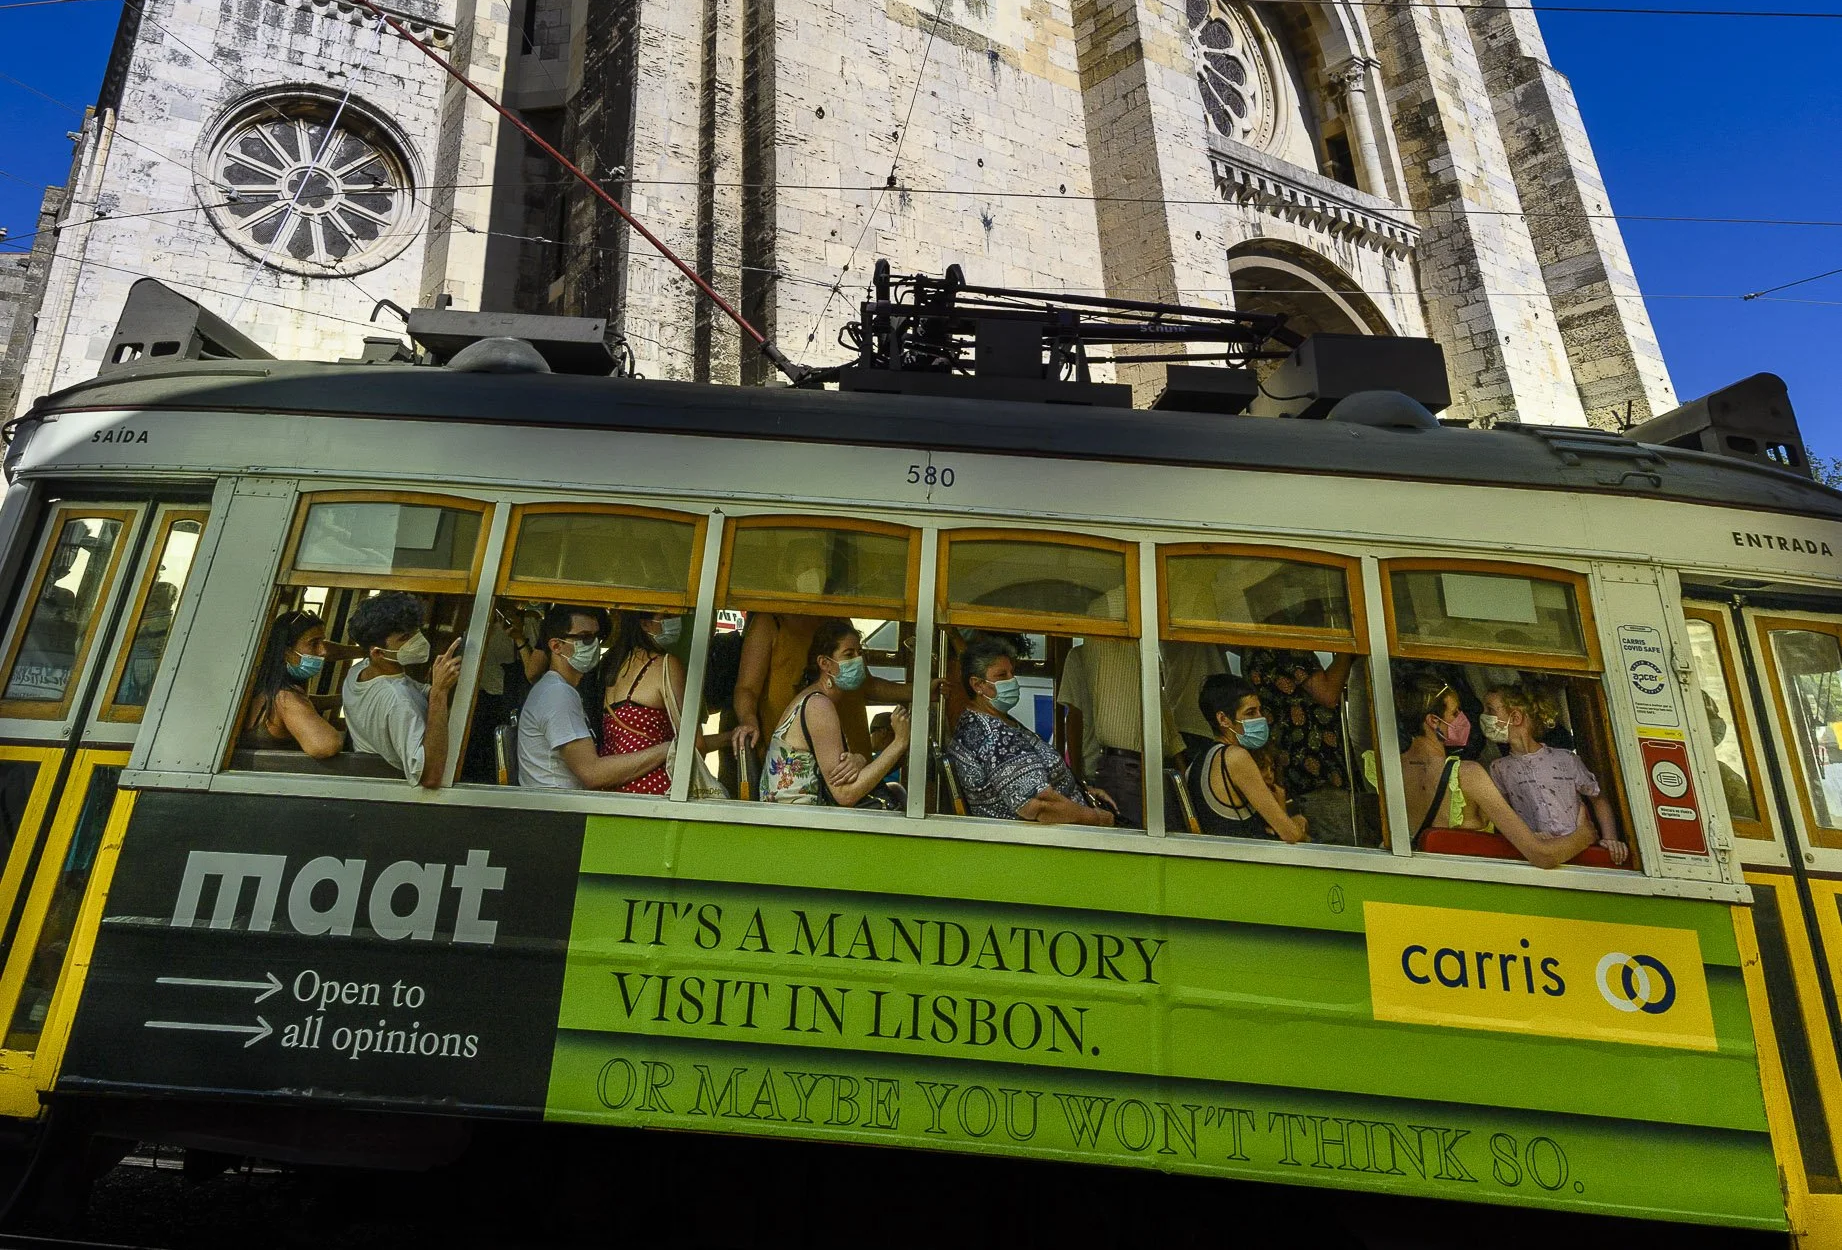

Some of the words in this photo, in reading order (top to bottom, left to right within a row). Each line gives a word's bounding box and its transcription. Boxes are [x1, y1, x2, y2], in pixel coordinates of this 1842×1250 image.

[91, 426, 149, 444] SAÍDA
[906, 464, 955, 488] 580
[1731, 531, 1834, 558] ENTRADA
[1621, 637, 1646, 646] CARRIS
[1623, 644, 1643, 652] COVID
[1643, 646, 1661, 654] SAFE
[169, 849, 507, 945] maat
[616, 898, 723, 950] IT'S
[734, 906, 776, 954] A
[785, 909, 1169, 985] MANDATORY
[1400, 937, 1567, 997] carris
[293, 969, 381, 1012] Open
[391, 979, 426, 1009] to
[609, 971, 770, 1029] VISIT
[781, 983, 853, 1037] IN
[864, 989, 1101, 1057] LISBON.
[280, 1015, 324, 1049] all
[331, 1019, 480, 1060] opinions
[596, 1057, 675, 1114] OR
[686, 1064, 901, 1131] MAYBE
[914, 1080, 1045, 1142] YOU
[1052, 1092, 1256, 1162] WON'T
[1268, 1112, 1479, 1183] THINK
[1488, 1132, 1586, 1194] SO.
